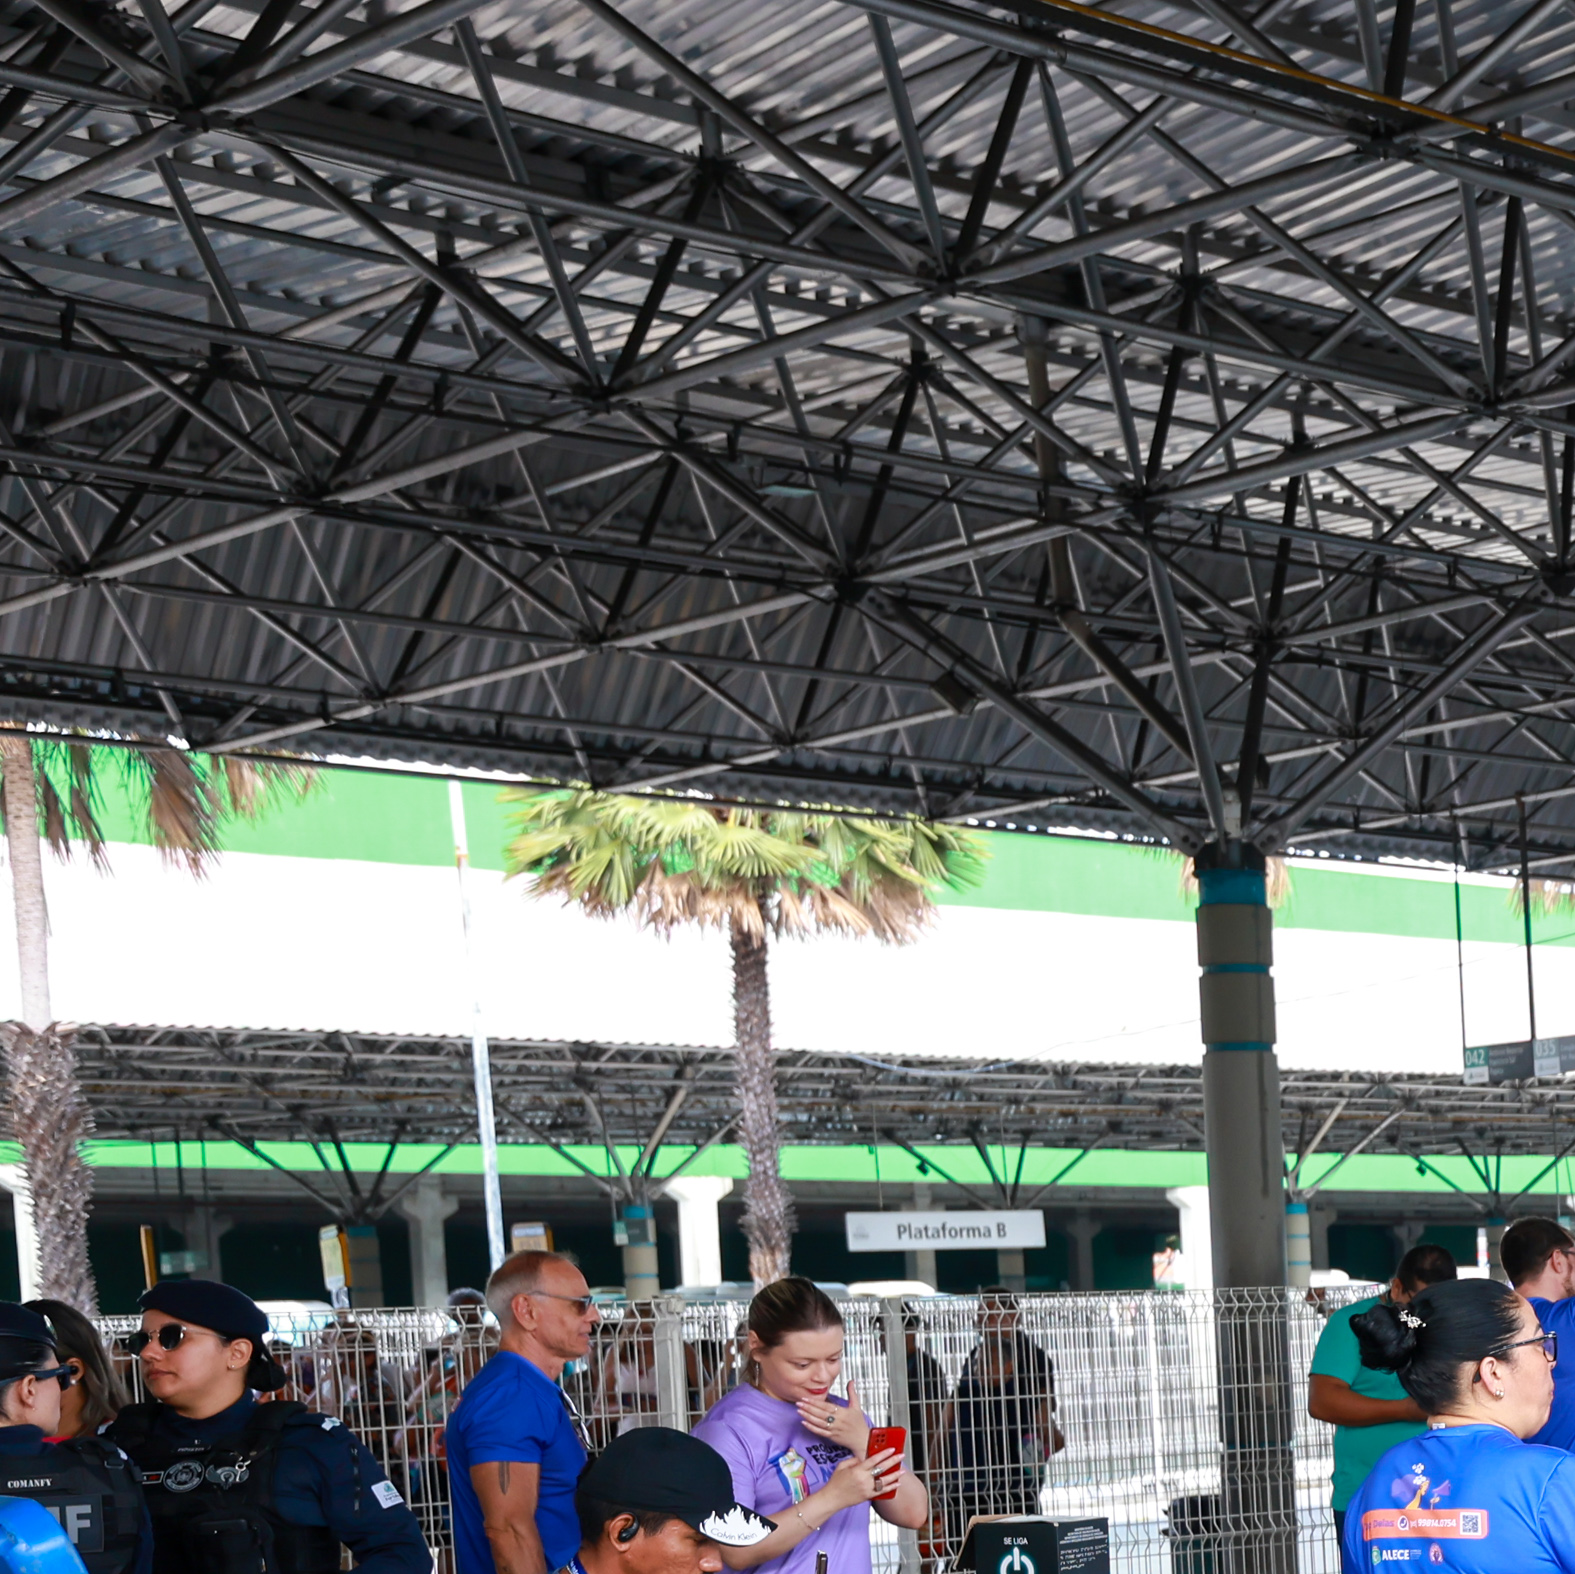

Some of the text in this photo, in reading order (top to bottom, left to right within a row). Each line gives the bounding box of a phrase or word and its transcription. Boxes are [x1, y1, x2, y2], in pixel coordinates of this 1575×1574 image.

[1535, 1040, 1556, 1056] 035
[1465, 1049, 1485, 1066] 042
[897, 1222, 1007, 1240] Plataforma B
[711, 1528, 758, 1541] Calvin Klein
[1003, 1537, 1029, 1545] SE LIGA
[1382, 1549, 1410, 1561] ALECE
